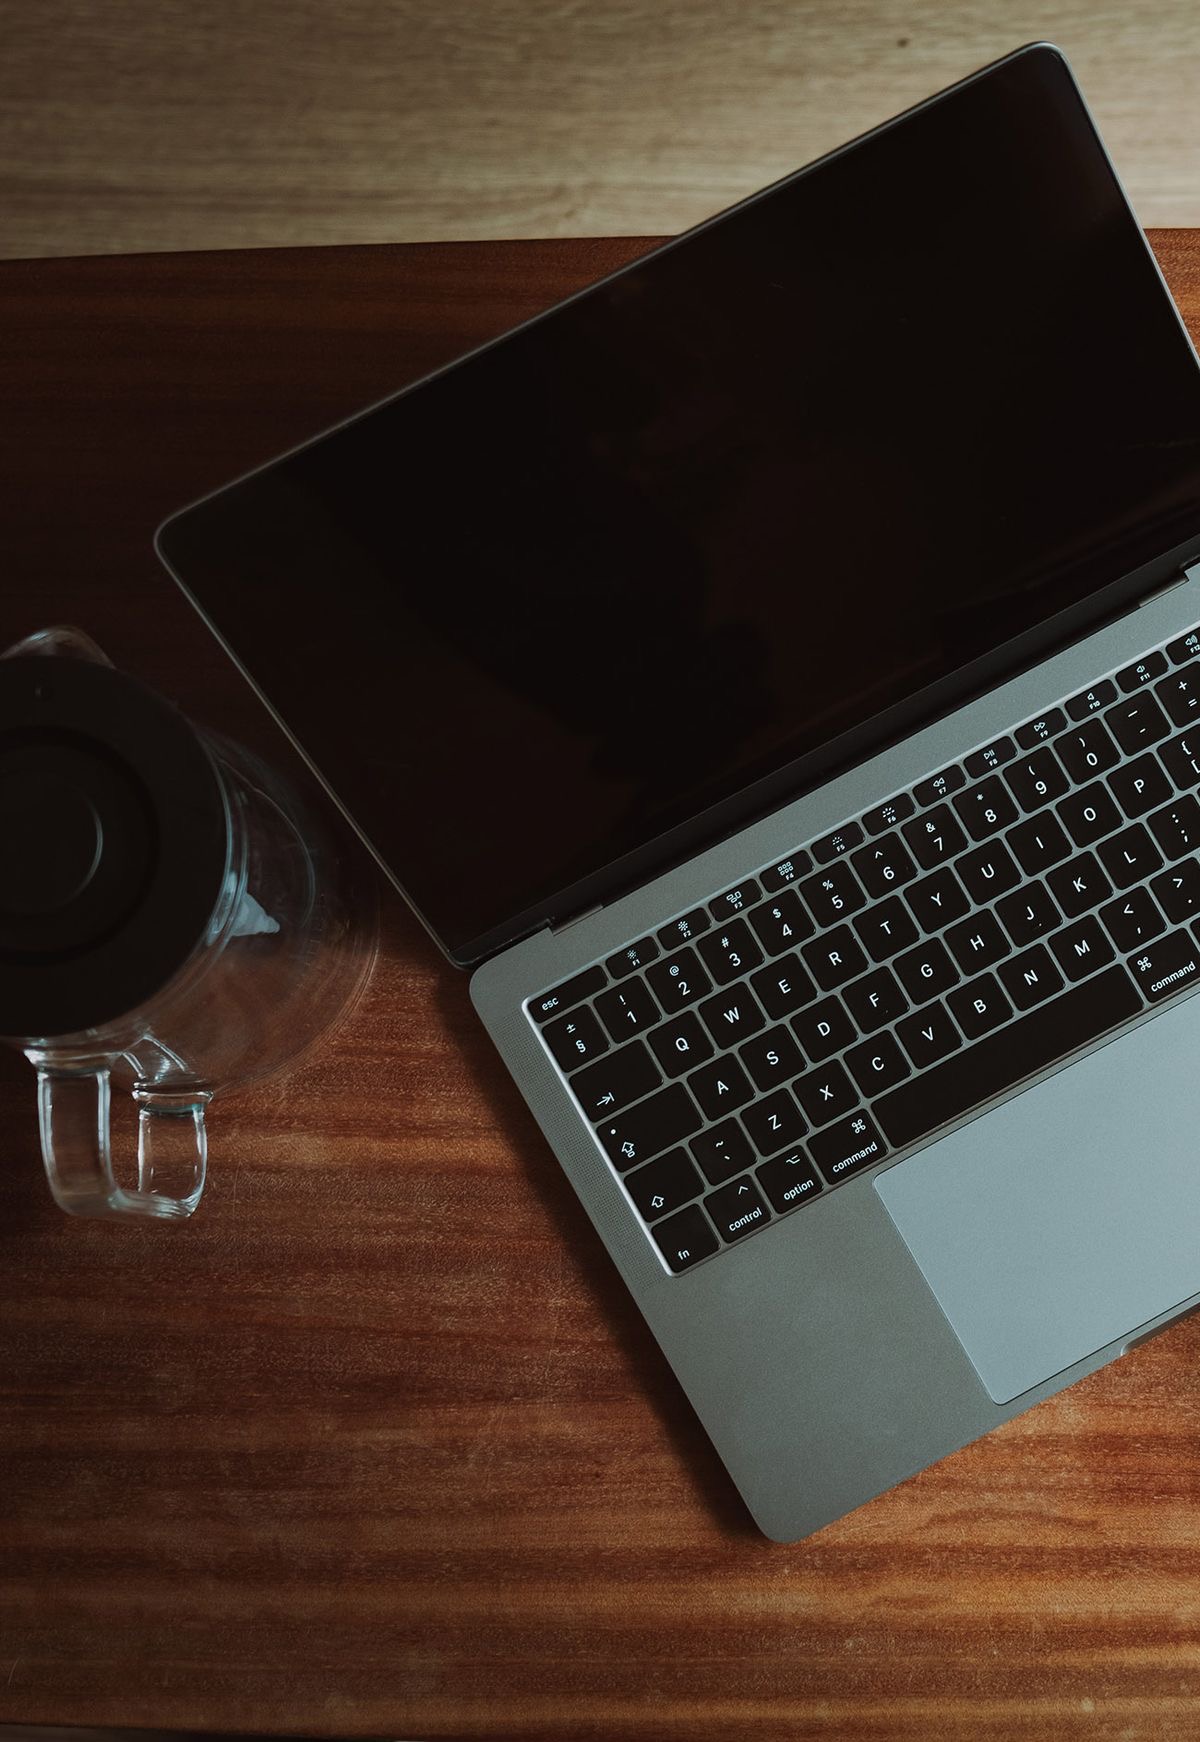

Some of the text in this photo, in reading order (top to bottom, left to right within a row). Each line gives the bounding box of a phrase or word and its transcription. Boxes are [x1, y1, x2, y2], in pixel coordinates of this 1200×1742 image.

[1189, 644, 1200, 654] F12
[1139, 673, 1152, 683] F11
[1179, 682, 1187, 690] +
[1089, 701, 1101, 710] F10
[1039, 730, 1049, 738] F9
[1182, 741, 1191, 754] {
[988, 759, 998, 767] F8
[1087, 753, 1097, 765] 0
[1191, 760, 1200, 773] [
[938, 787, 947, 795] F7
[1036, 781, 1046, 794] 9
[1134, 779, 1144, 793] P
[887, 816, 897, 824] F6
[985, 809, 996, 822] 8
[1084, 808, 1096, 821] O
[926, 823, 935, 832] &
[934, 837, 942, 851] 7
[1036, 837, 1043, 848] I
[1124, 852, 1136, 863] L
[785, 873, 795, 881] F4
[884, 867, 894, 879] 6
[981, 864, 994, 878] U
[823, 880, 833, 890] %
[1073, 877, 1086, 892] K
[1173, 879, 1182, 888] >
[733, 901, 743, 910] F3
[832, 895, 843, 908] 5
[931, 893, 941, 906] Y
[773, 909, 781, 918] $
[1027, 906, 1034, 920] J
[1124, 904, 1133, 913] <
[682, 930, 692, 938] F2
[783, 924, 792, 936] 4
[880, 921, 890, 934] T
[722, 937, 728, 947] #
[970, 935, 984, 950] H
[1075, 940, 1090, 956] M
[729, 953, 740, 966] 3
[829, 952, 842, 965] R
[670, 966, 679, 976] @
[921, 964, 933, 977] G
[1150, 961, 1196, 993] command
[1024, 970, 1038, 985] N
[679, 982, 690, 995] 2
[779, 979, 790, 993] E
[541, 997, 558, 1010] esc
[870, 993, 879, 1007] F
[974, 1000, 986, 1013] B
[628, 1011, 636, 1022] 1
[724, 1007, 739, 1023] W
[818, 1022, 830, 1036] D
[922, 1027, 933, 1040] V
[576, 1040, 585, 1052] §
[676, 1038, 689, 1051] Q
[767, 1051, 778, 1064] S
[872, 1057, 884, 1070] C
[718, 1081, 728, 1094] A
[820, 1085, 833, 1100] X
[768, 1115, 781, 1129] Z
[833, 1142, 878, 1173] command
[783, 1178, 814, 1201] option
[729, 1208, 763, 1232] control
[678, 1250, 689, 1259] fn
